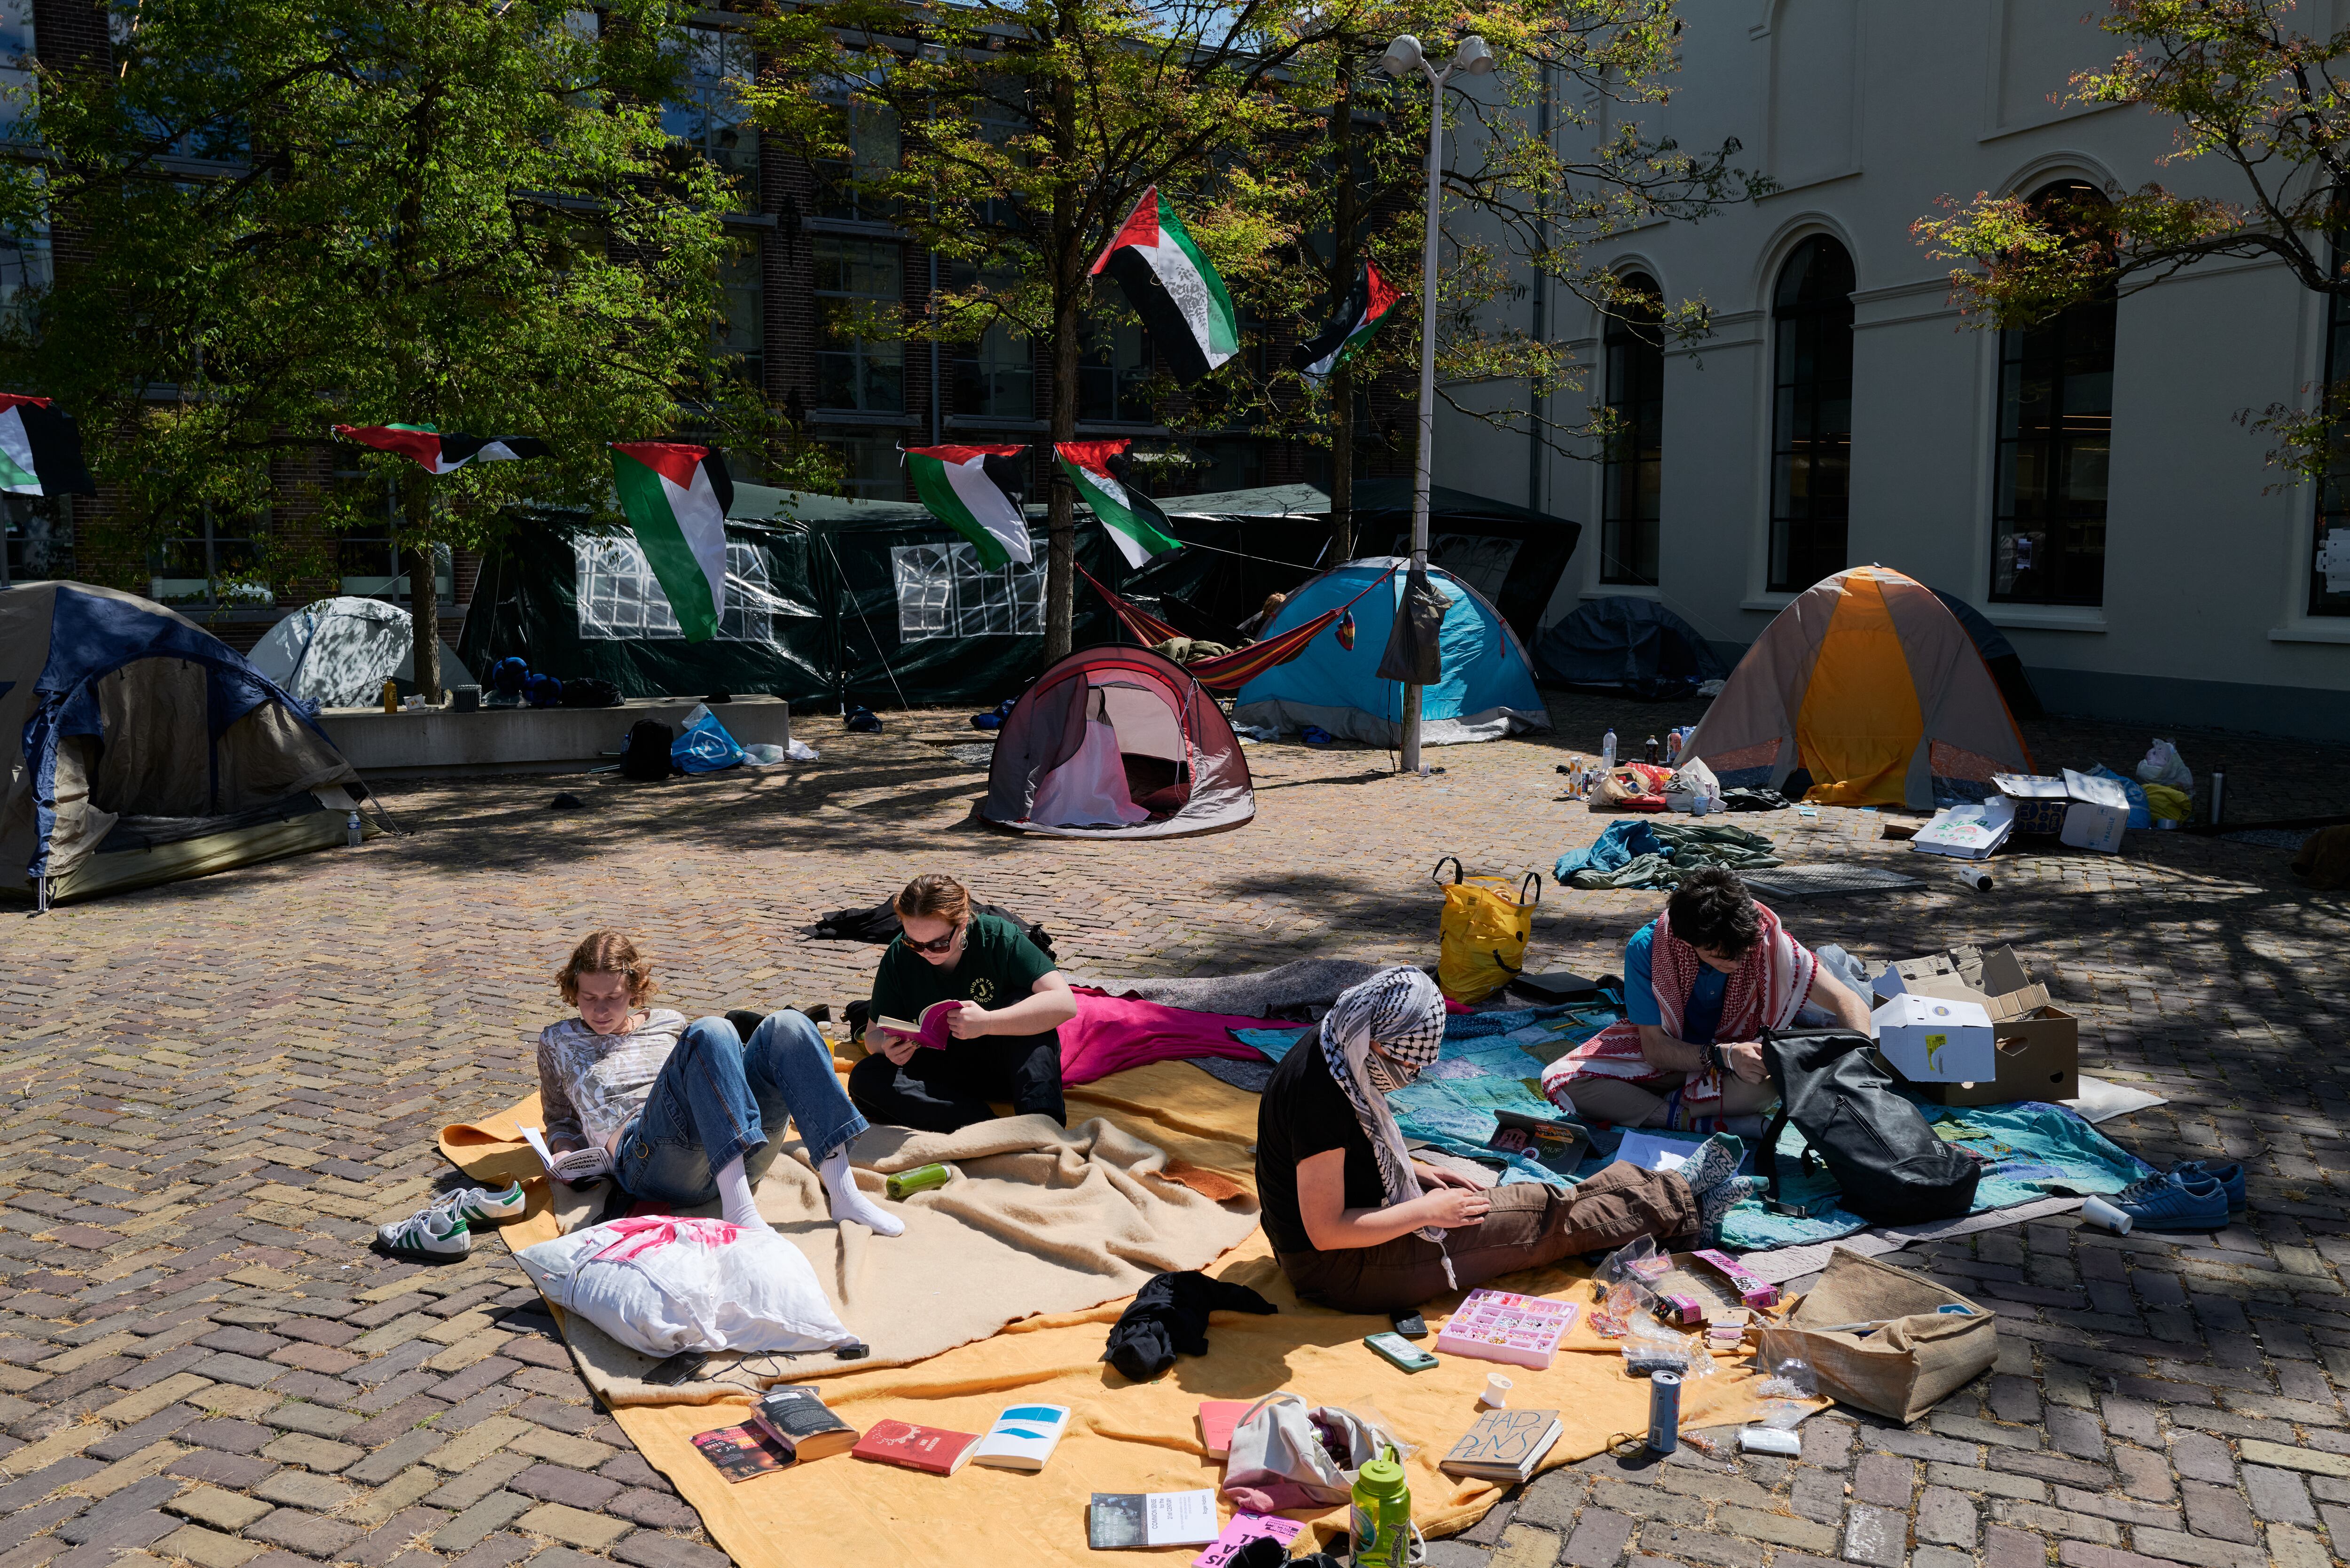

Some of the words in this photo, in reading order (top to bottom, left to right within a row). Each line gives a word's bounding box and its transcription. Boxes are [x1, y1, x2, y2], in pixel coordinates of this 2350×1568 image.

[2103, 817, 2115, 842] FRAGILE
[970, 978, 984, 994] WIDEN
[986, 979, 994, 990] THE
[974, 994, 994, 1003] CIRCLE
[559, 1158, 601, 1171] Anarchist
[561, 1155, 593, 1166] Jewish
[1732, 1276, 1755, 1291] BEADS
[1476, 1411, 1541, 1438] HAP
[705, 1441, 725, 1450] Sun
[924, 1437, 941, 1451] MARXISM
[1449, 1426, 1540, 1458] PENS
[1267, 1521, 1292, 1530] rebellion
[1270, 1527, 1297, 1537] extinction
[1222, 1544, 1238, 1554] A
[1205, 1555, 1226, 1566] IS
